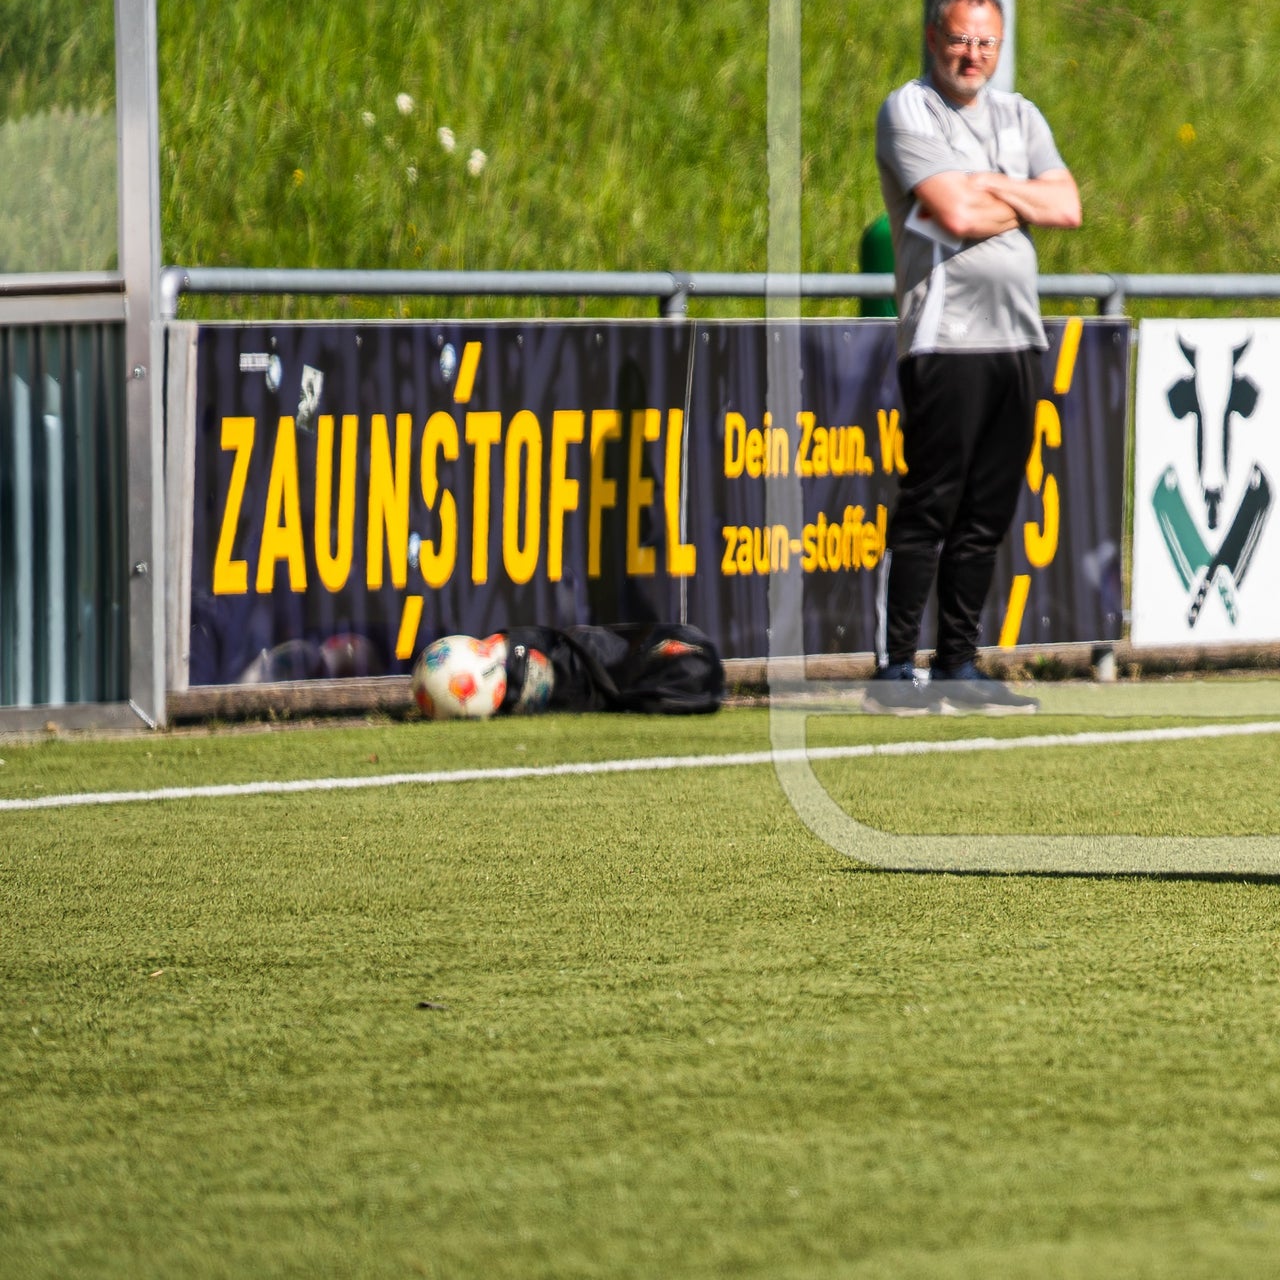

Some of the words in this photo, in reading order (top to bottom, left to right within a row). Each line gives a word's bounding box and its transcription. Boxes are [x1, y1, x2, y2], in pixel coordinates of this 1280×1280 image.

[212, 408, 696, 596] ZAUNSTOFFEL
[723, 410, 790, 479] Dein
[794, 410, 875, 478] Zaun.
